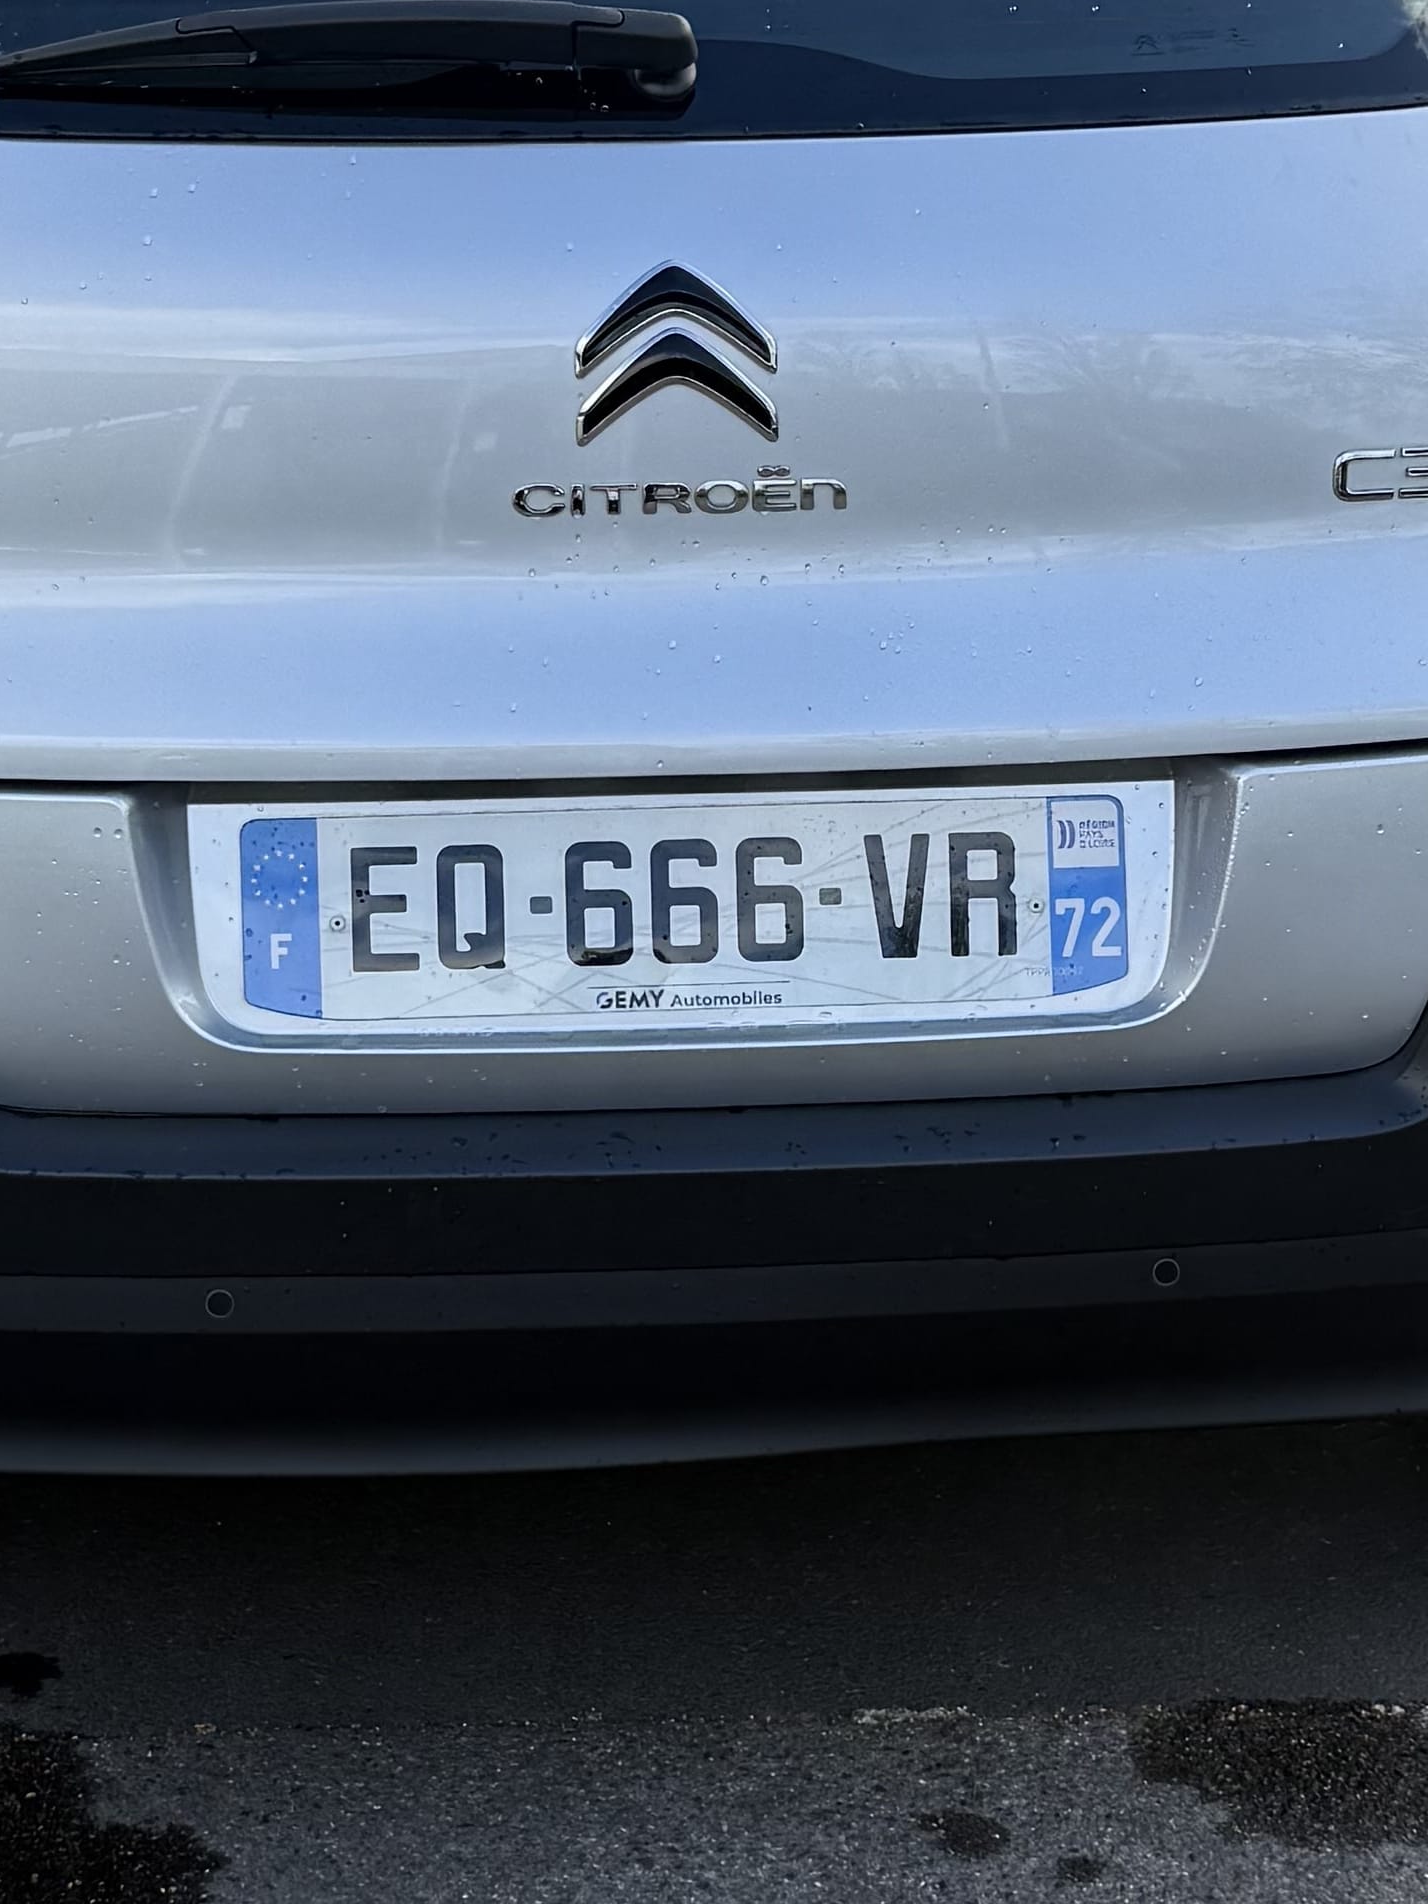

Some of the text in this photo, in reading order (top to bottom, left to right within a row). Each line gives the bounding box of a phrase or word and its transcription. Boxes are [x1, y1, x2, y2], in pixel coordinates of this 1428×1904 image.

[349, 832, 1017, 973] EQ-666-VR
[1054, 896, 1122, 958] 72
[270, 933, 293, 970] F
[596, 989, 783, 1009] GEMY Automobiles
